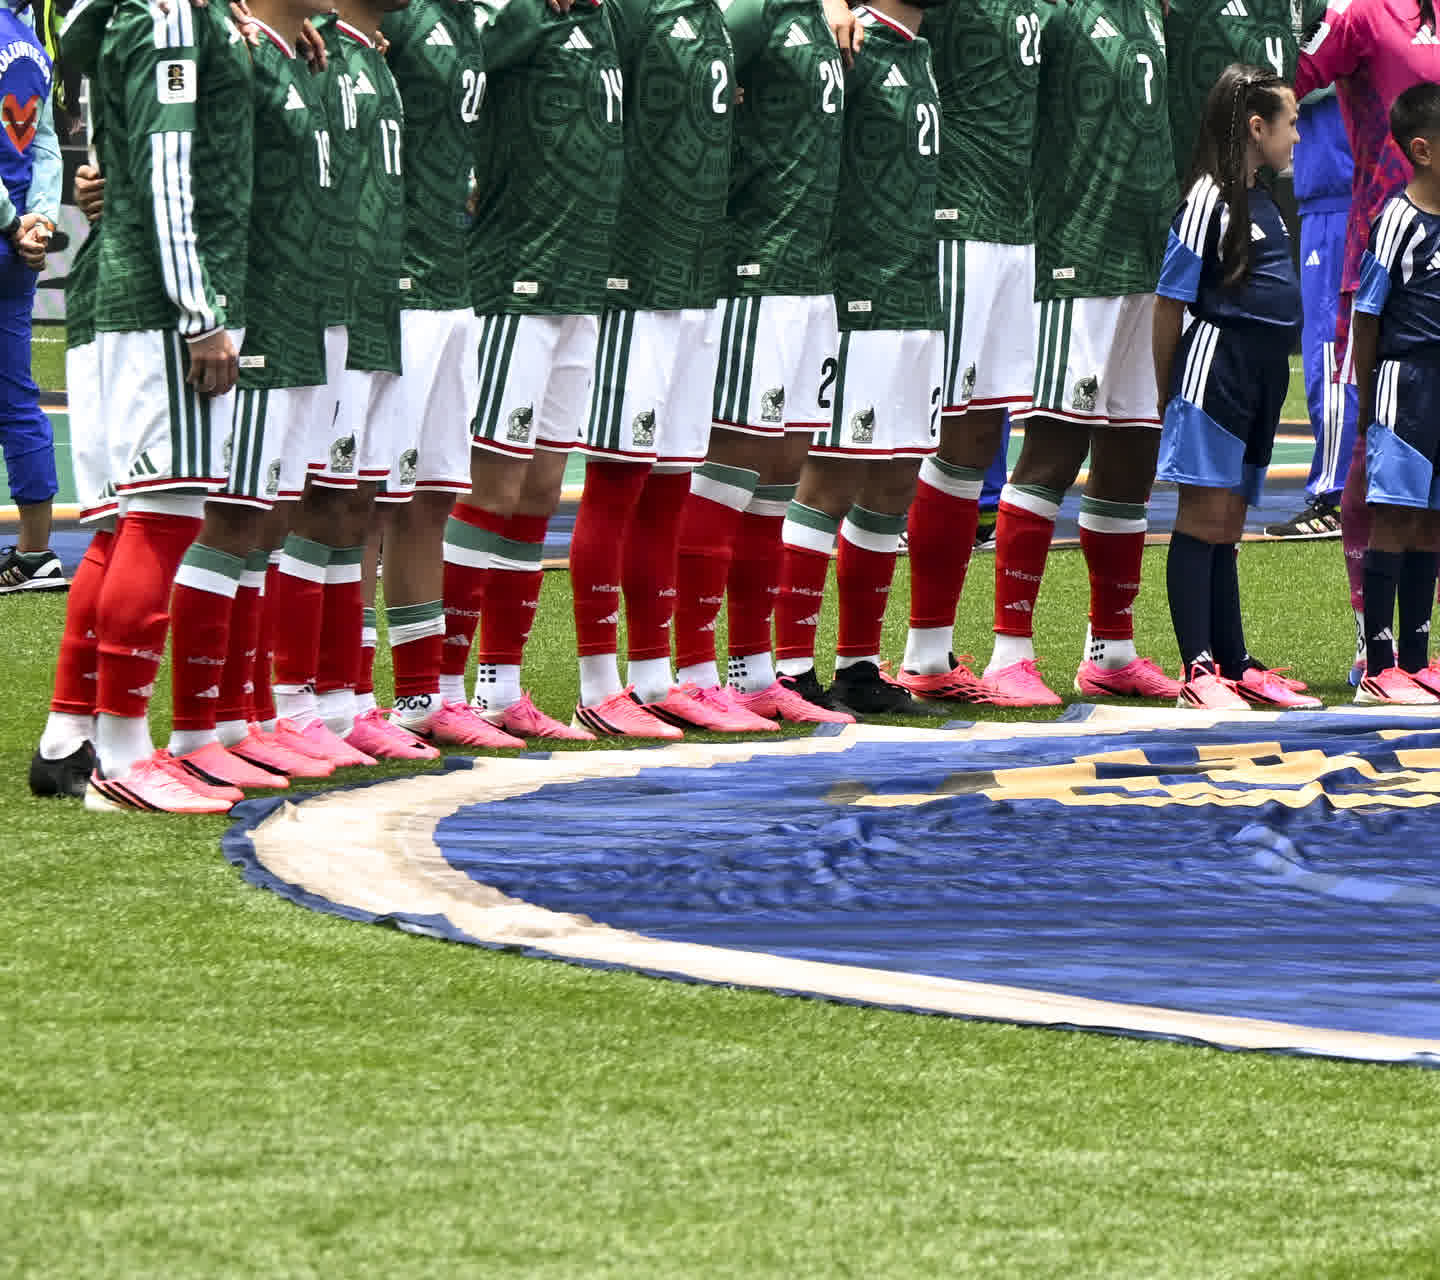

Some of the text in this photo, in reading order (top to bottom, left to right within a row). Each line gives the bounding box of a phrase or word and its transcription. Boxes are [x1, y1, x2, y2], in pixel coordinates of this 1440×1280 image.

[1015, 14, 1042, 67] 22
[1265, 37, 1284, 78] 4
[460, 69, 487, 123] 20
[599, 69, 624, 123] 14
[710, 59, 728, 114] 2
[818, 59, 844, 114] 24
[1136, 53, 1153, 105] 7
[379, 118, 401, 177] 17
[916, 103, 940, 155] 21
